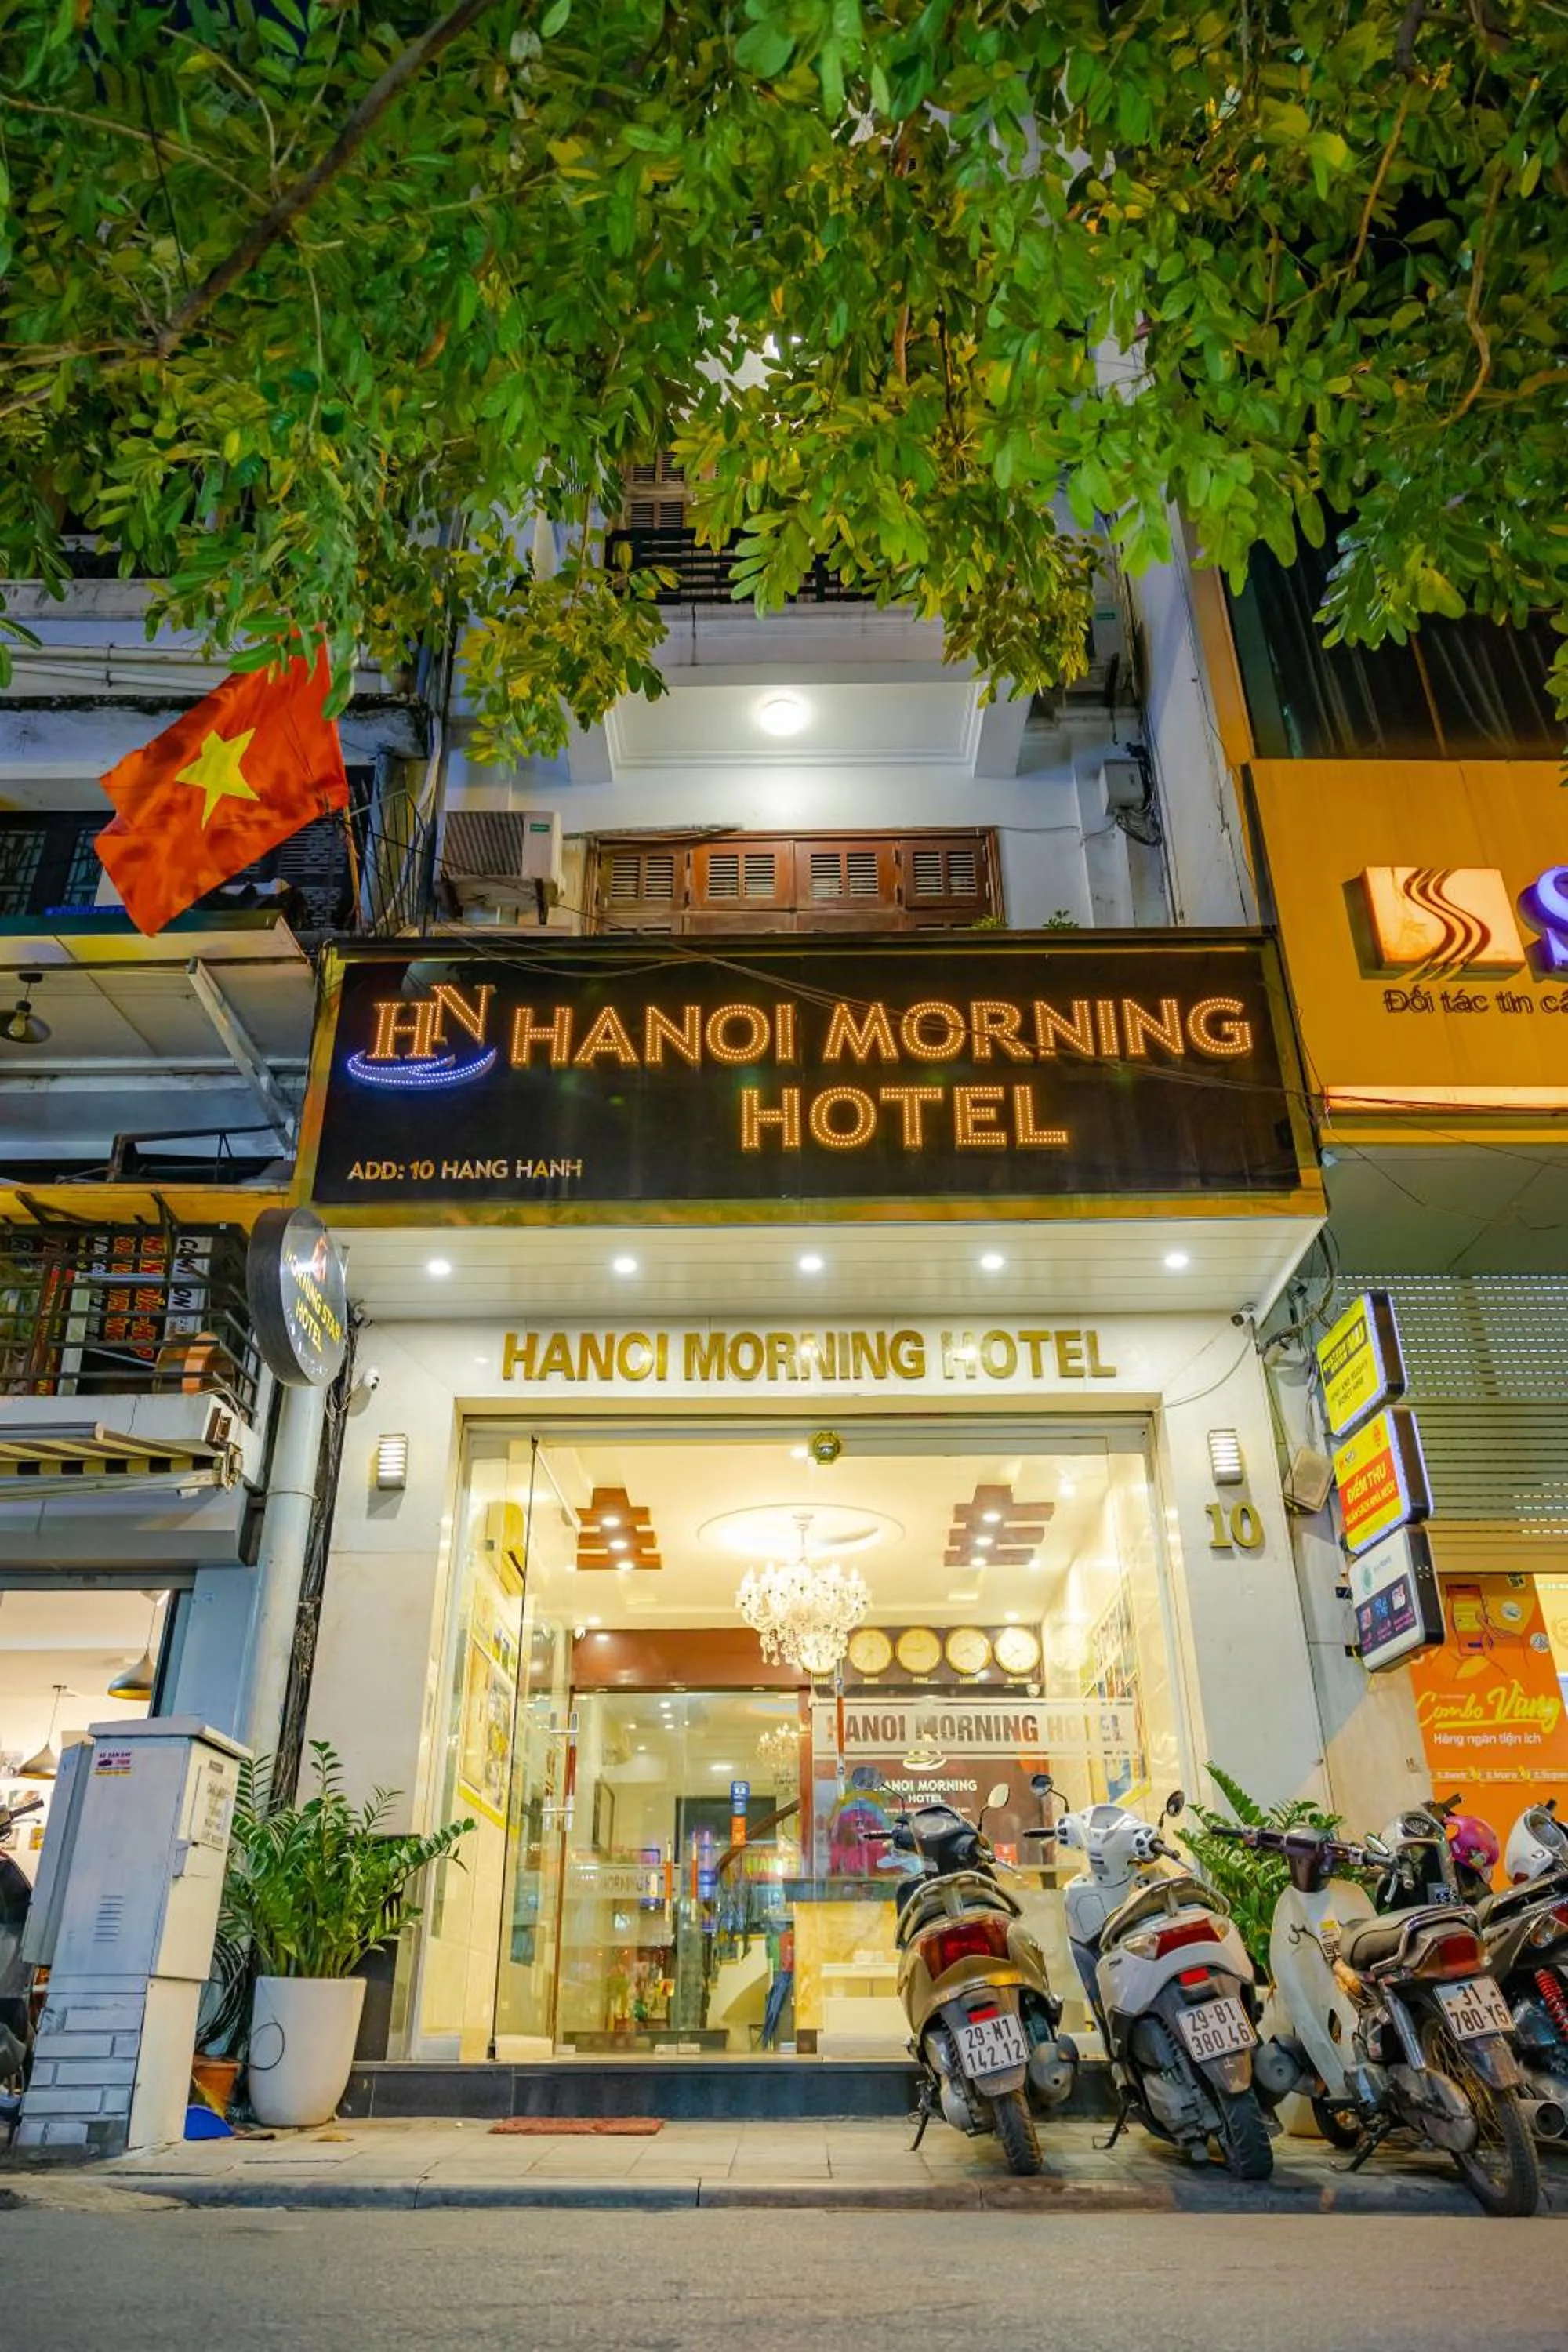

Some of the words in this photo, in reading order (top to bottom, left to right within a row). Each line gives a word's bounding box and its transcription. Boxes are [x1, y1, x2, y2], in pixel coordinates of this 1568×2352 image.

[1384, 985, 1435, 1013] Đối
[1440, 989, 1489, 1013] tác
[1496, 990, 1534, 1014] tin
[510, 1003, 795, 1069] HANOI
[822, 997, 1253, 1064] MORNING
[741, 1085, 1069, 1152] HOTEL
[347, 1161, 405, 1180] ADD:
[409, 1160, 434, 1179] 10
[441, 1160, 508, 1179] HANG
[516, 1159, 582, 1178] HANH
[503, 1332, 669, 1381] HANOI
[684, 1330, 926, 1381] MORNING
[941, 1329, 1117, 1380] HOTEL
[1205, 1501, 1264, 1548] 10
[915, 1715, 1039, 1742] MORNING
[908, 1793, 946, 1803] HOTEL
[918, 1779, 978, 1791] MORNING
[1186, 2001, 1236, 2033] 29-B1
[967, 2038, 1025, 2072] 142.12
[1191, 2022, 1250, 2056] 380.46
